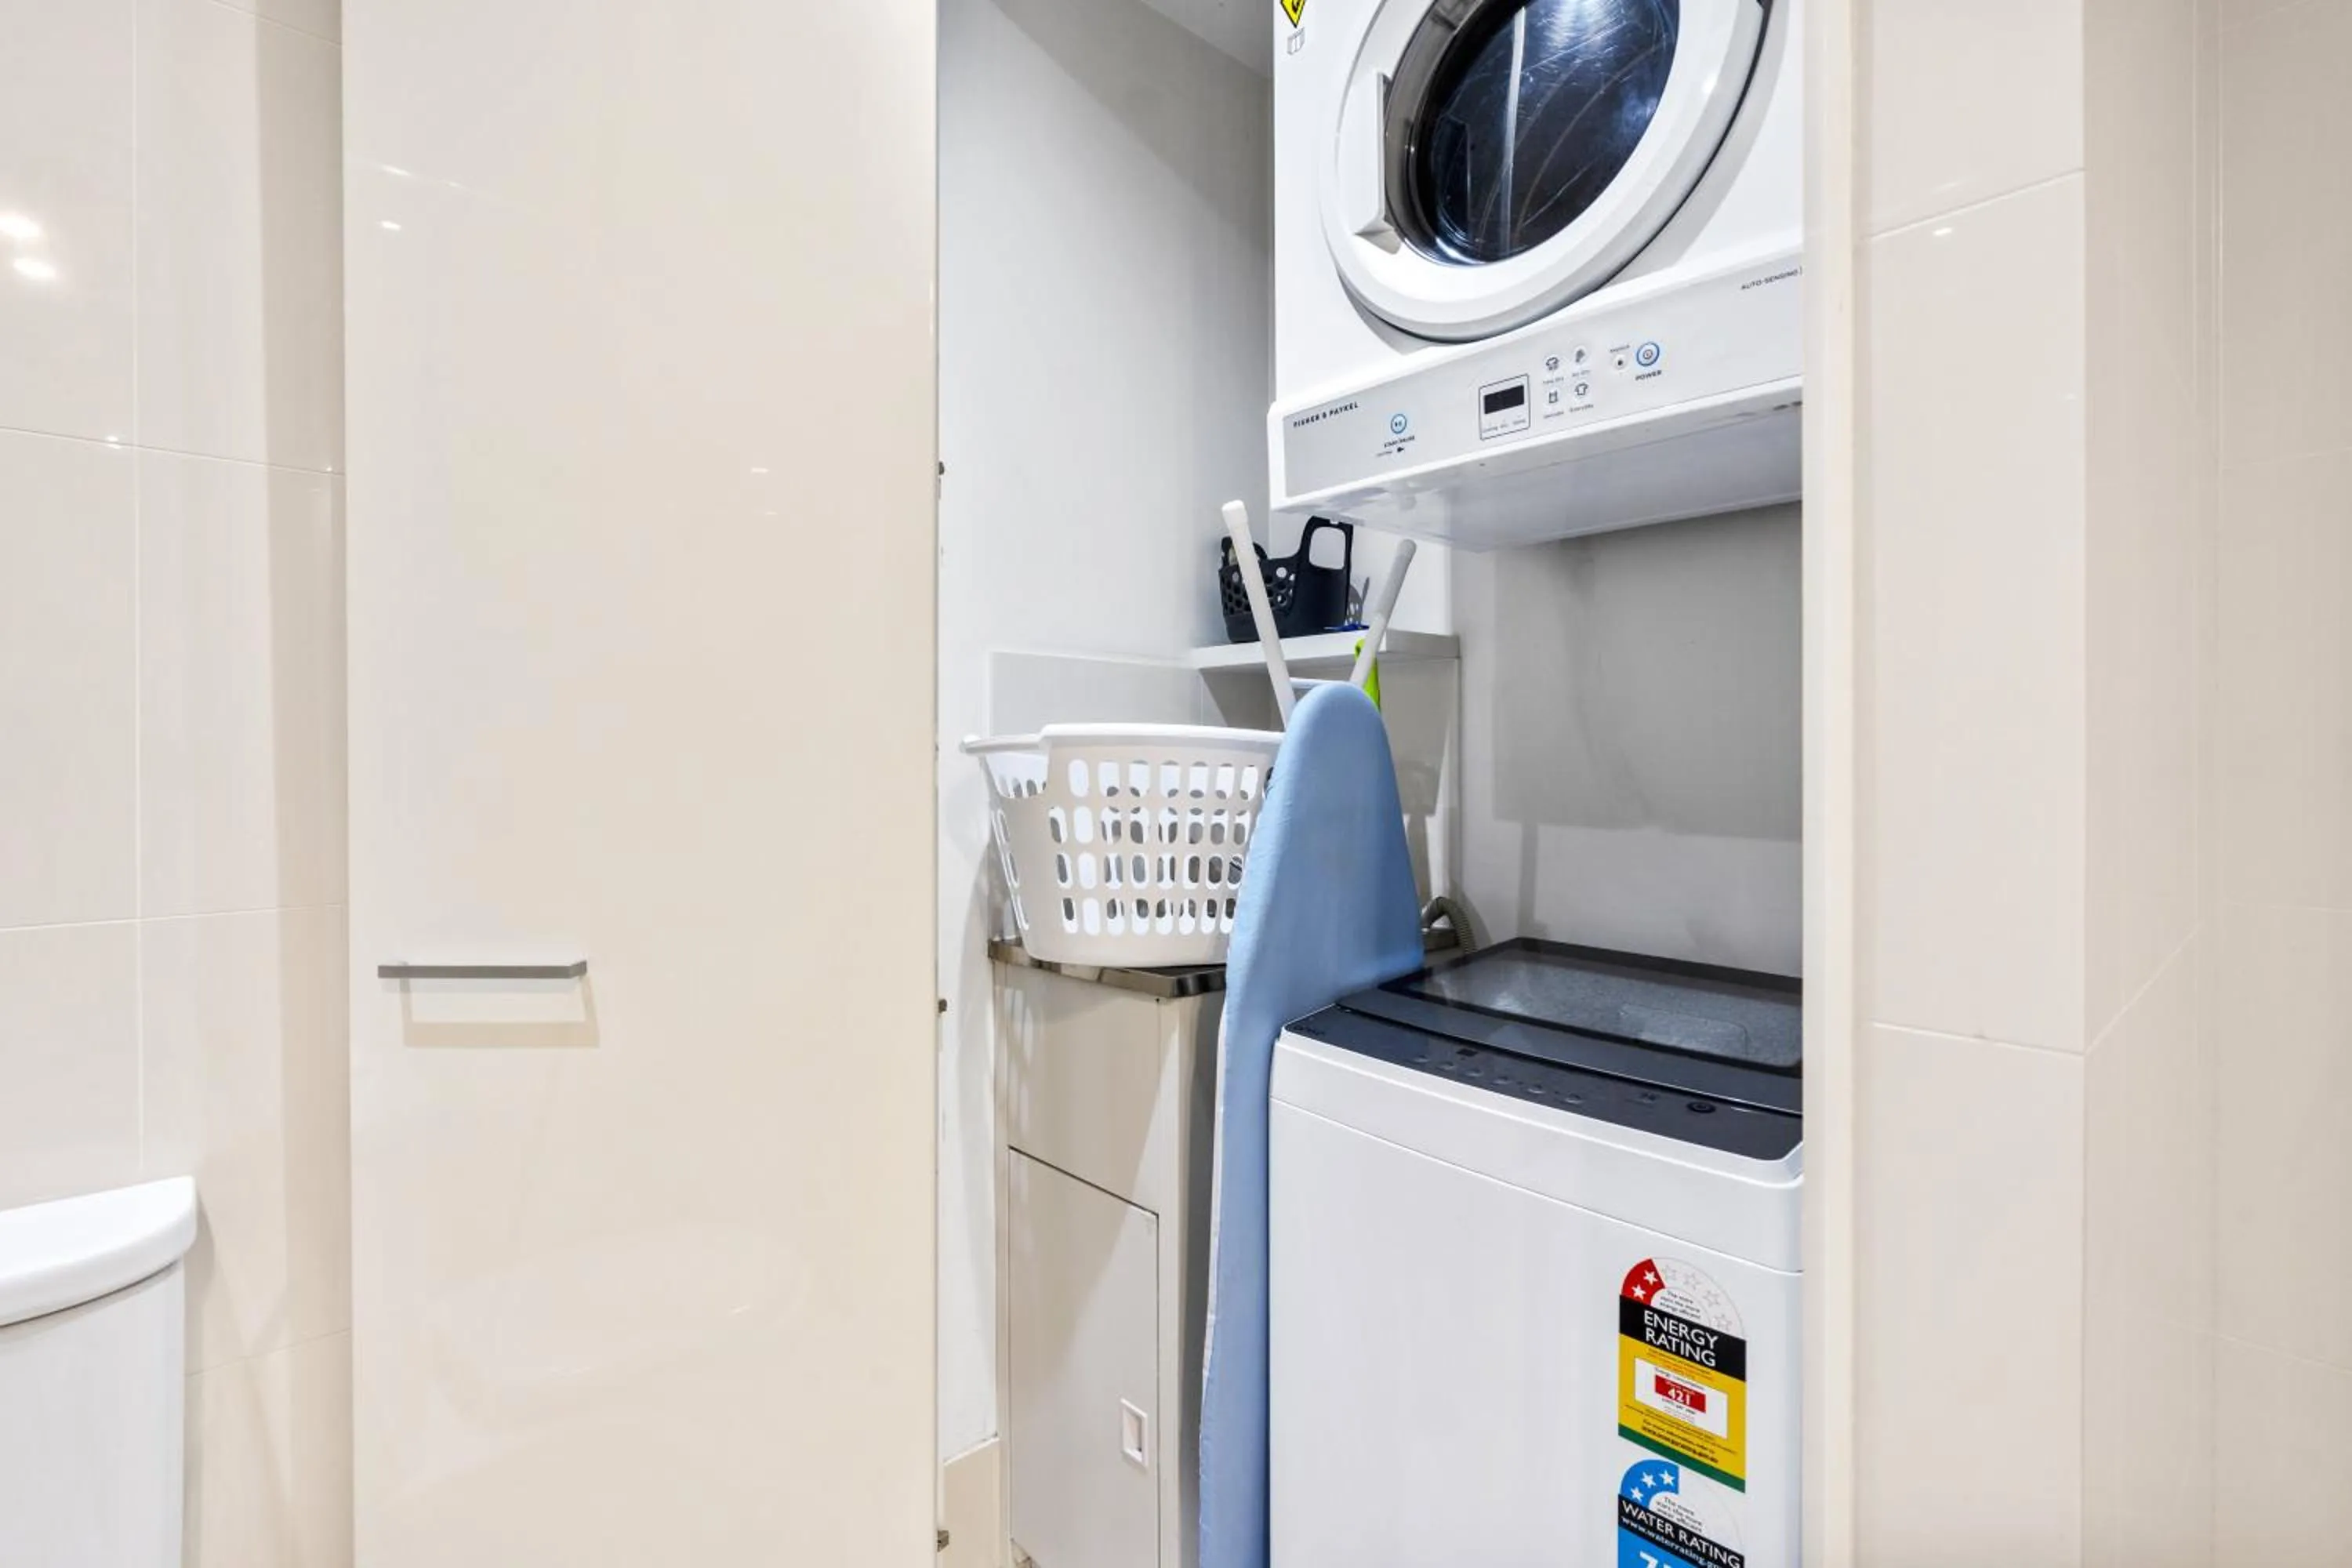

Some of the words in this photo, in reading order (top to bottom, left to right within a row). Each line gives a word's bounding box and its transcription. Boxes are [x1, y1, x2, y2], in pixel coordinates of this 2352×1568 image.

[1635, 370, 1661, 381] POWER
[1293, 413, 1319, 427] FISHER
[1328, 401, 1359, 417] PAYKEL
[1644, 1309, 1719, 1349] ENERGY
[1646, 1328, 1716, 1367] RATING
[1668, 1388, 1690, 1406] 421
[1621, 1500, 1675, 1538] WATER
[1679, 1529, 1740, 1568] RATING
